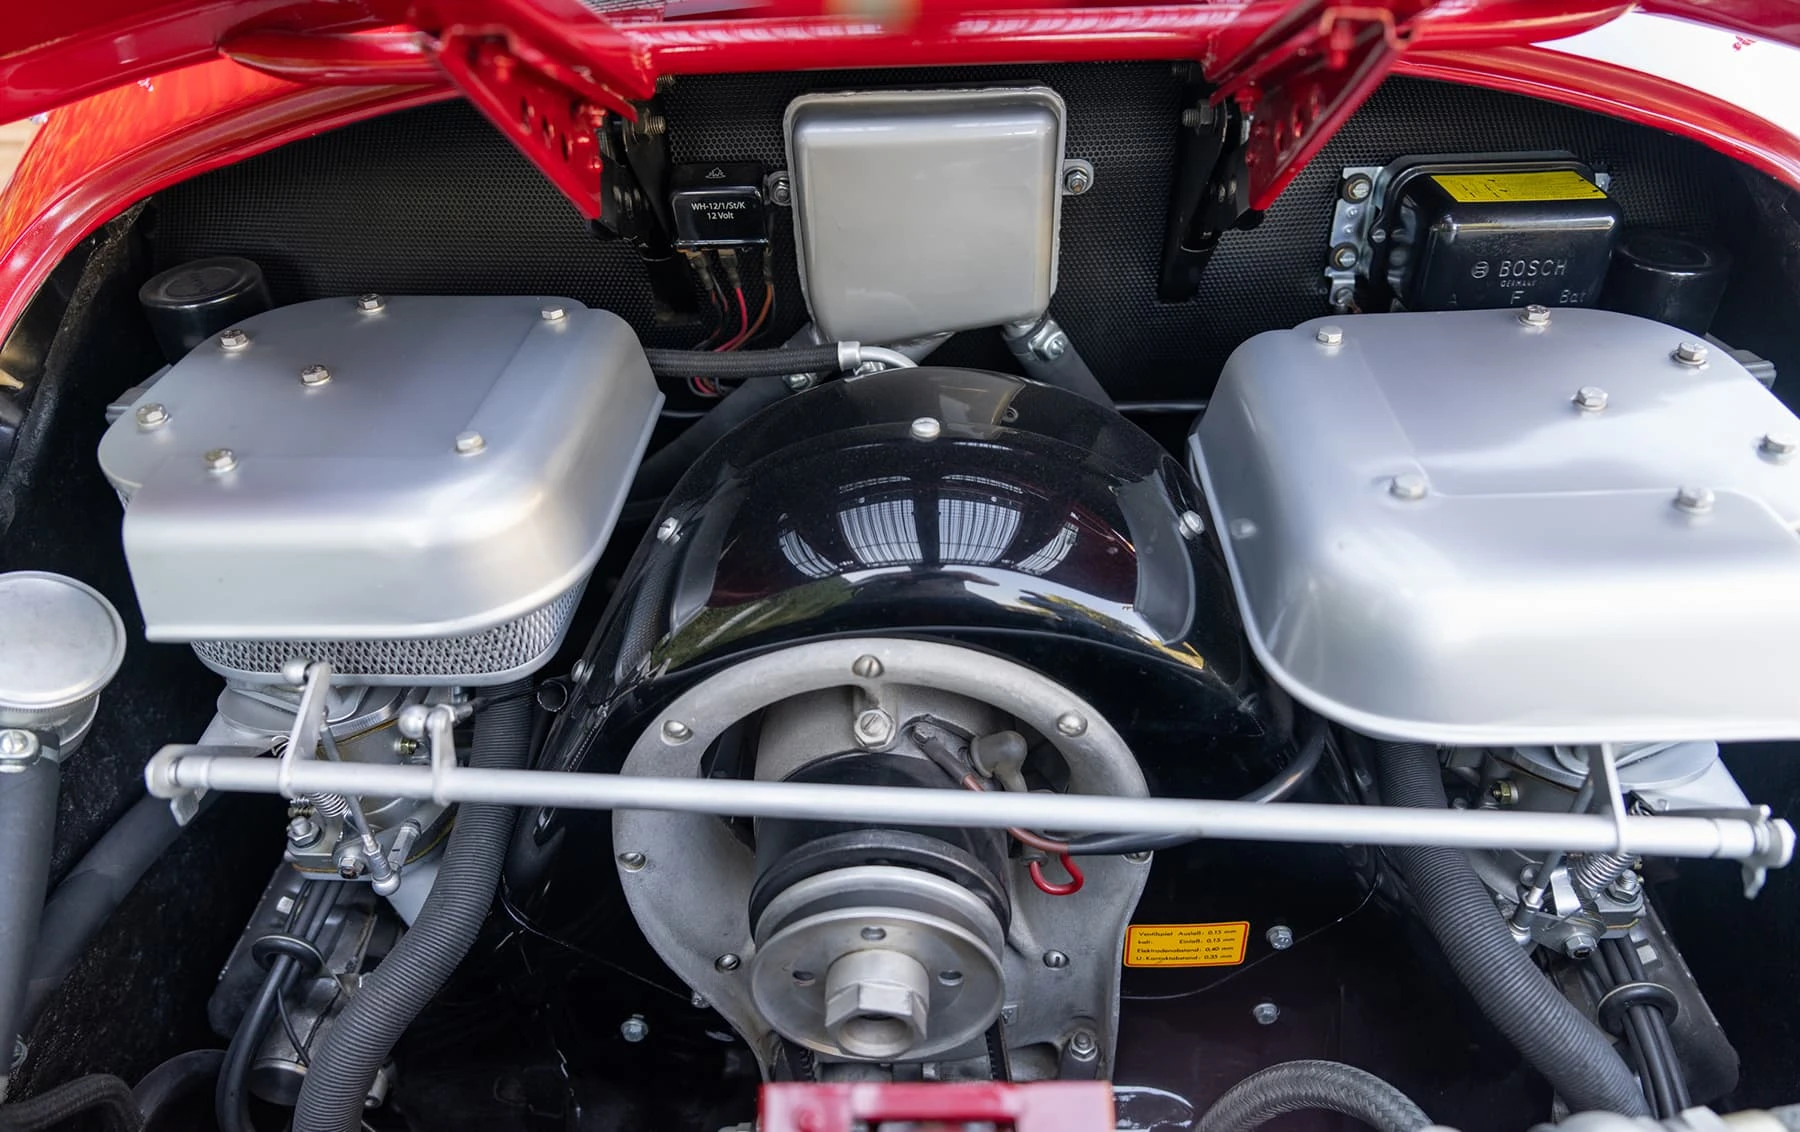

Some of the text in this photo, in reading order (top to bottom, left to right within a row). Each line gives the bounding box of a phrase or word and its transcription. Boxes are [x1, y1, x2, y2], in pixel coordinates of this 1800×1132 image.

[690, 201, 746, 211] WH-12/1/St/K
[707, 211, 735, 220] 12 Volt
[1498, 259, 1568, 277] BOSCH
[1510, 290, 1525, 305] F
